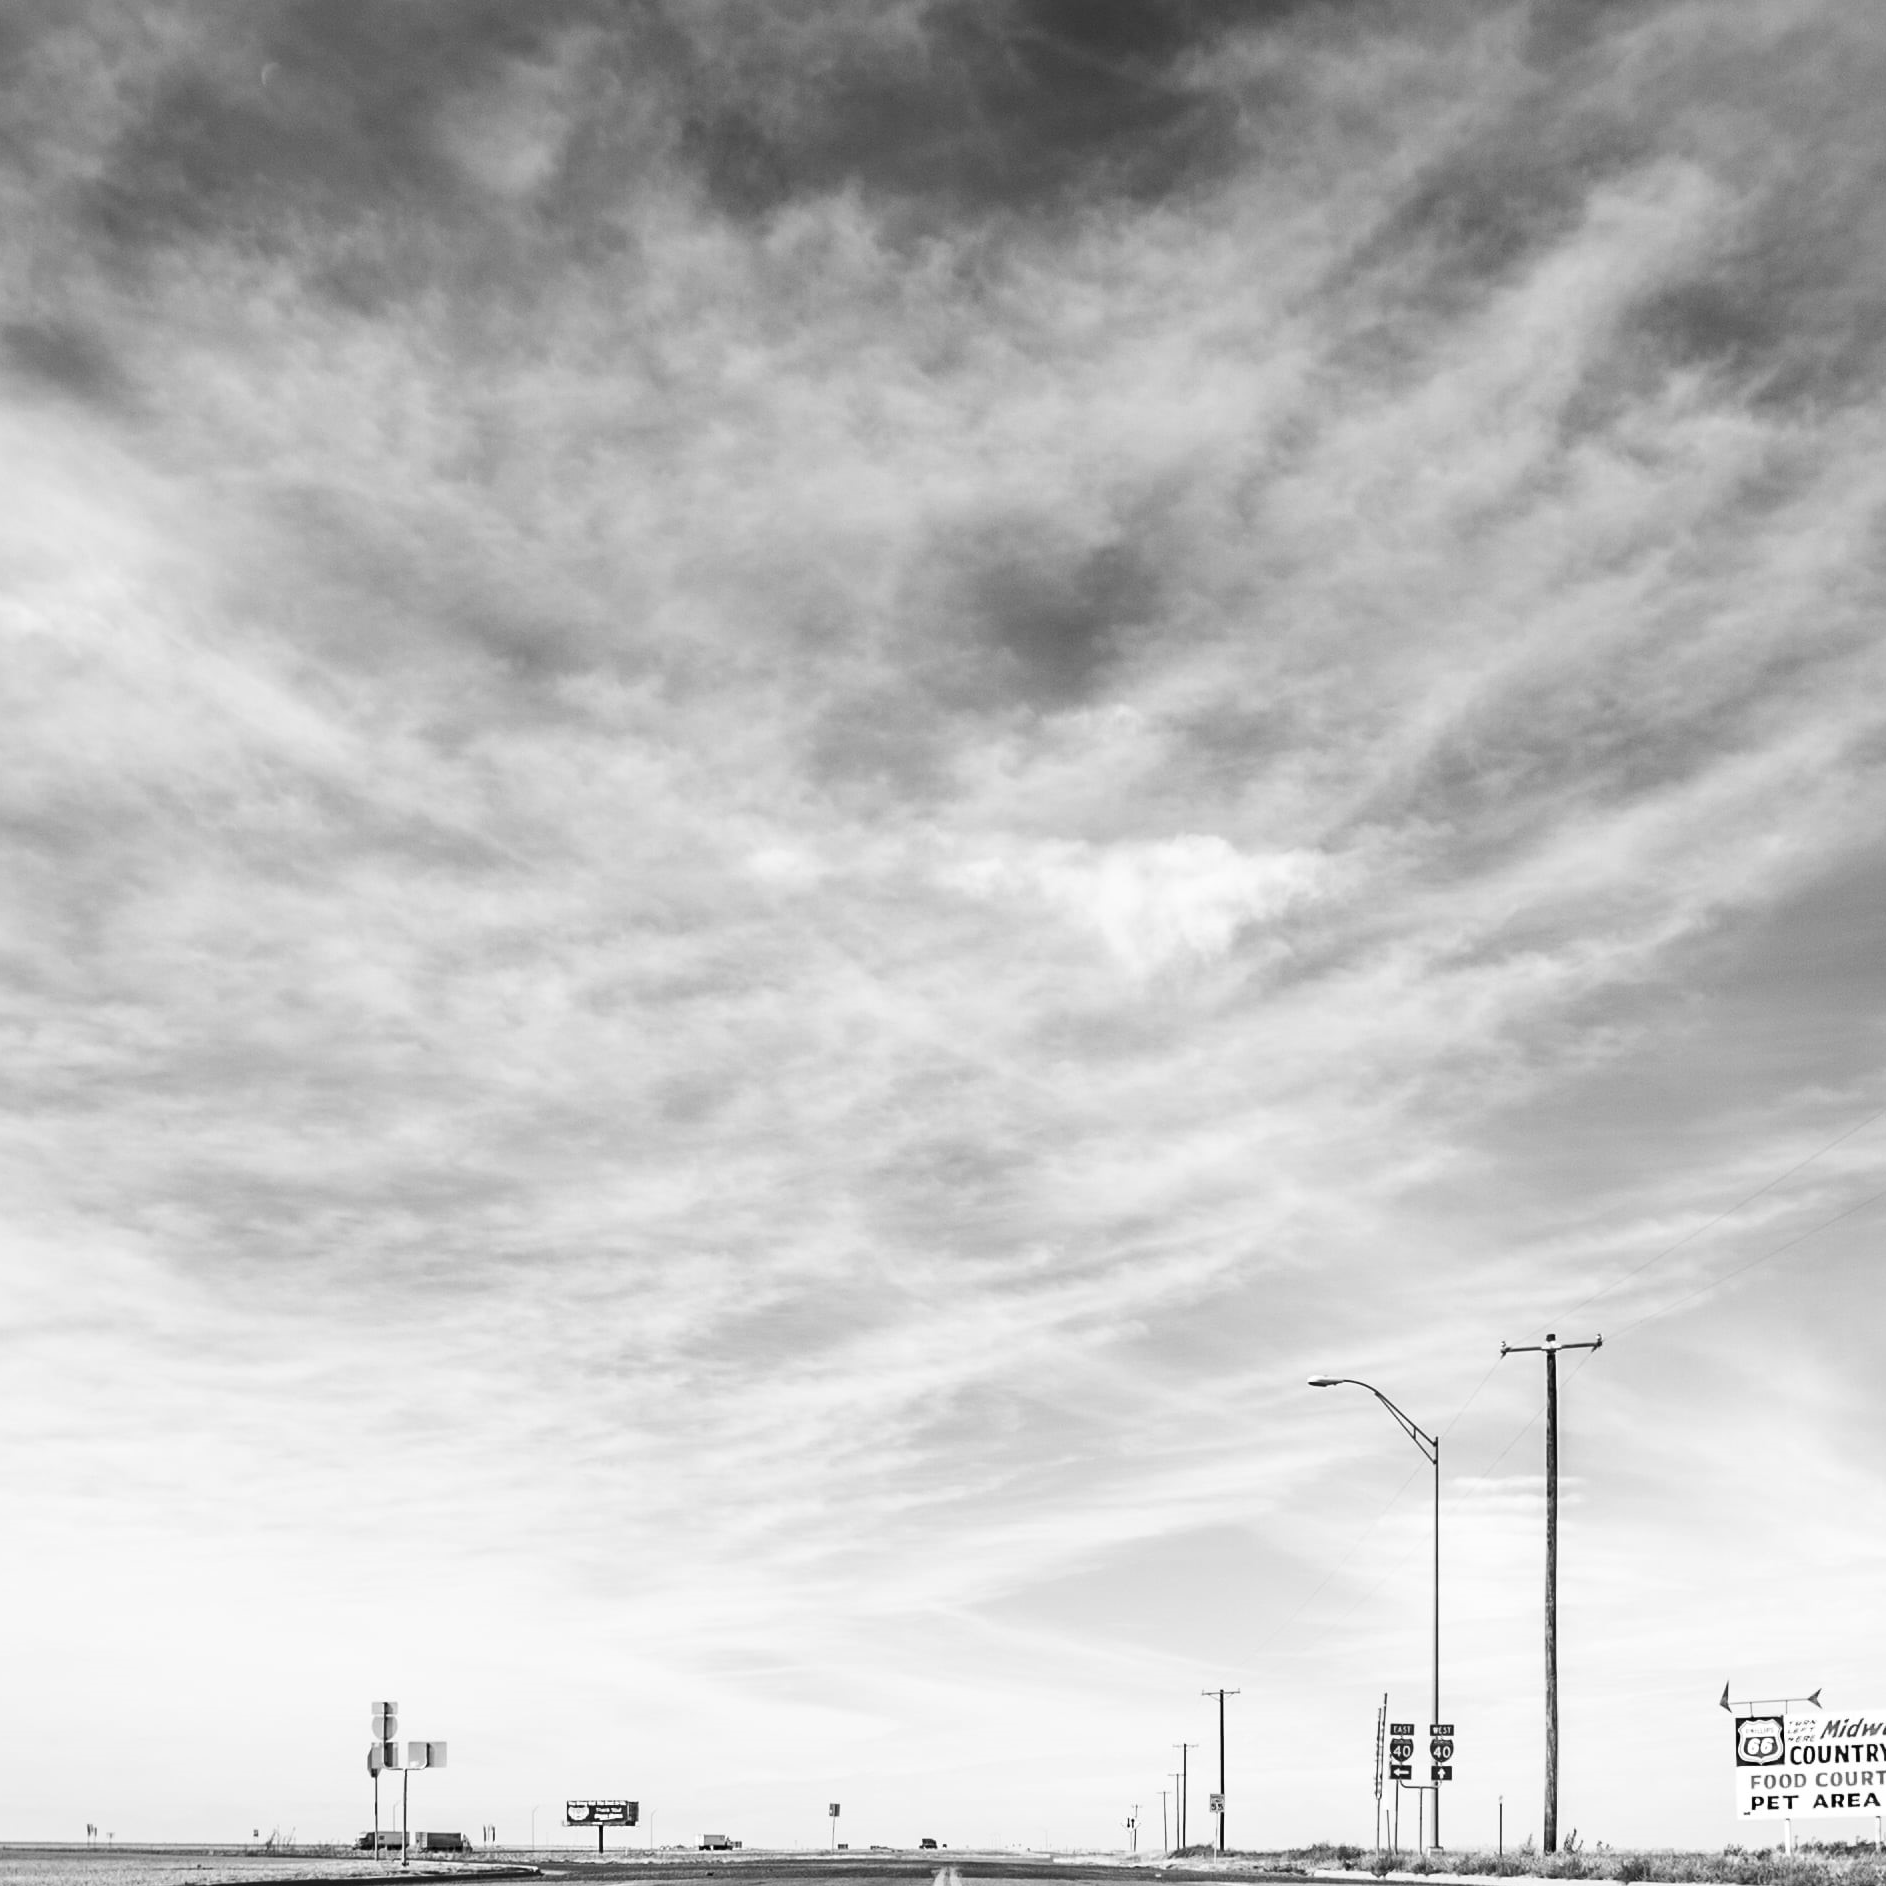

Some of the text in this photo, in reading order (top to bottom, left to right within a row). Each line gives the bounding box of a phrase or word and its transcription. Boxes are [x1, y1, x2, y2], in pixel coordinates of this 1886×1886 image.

[1394, 1725, 1412, 1734] EAST
[1433, 1726, 1452, 1735] WEST
[1393, 1745, 1411, 1758] 40
[1433, 1746, 1451, 1759] 40
[1747, 1737, 1775, 1755] 66
[1750, 1773, 1807, 1790] FOOD
[1751, 1795, 1799, 1810] PET
[1812, 1792, 1881, 1808] AREA
